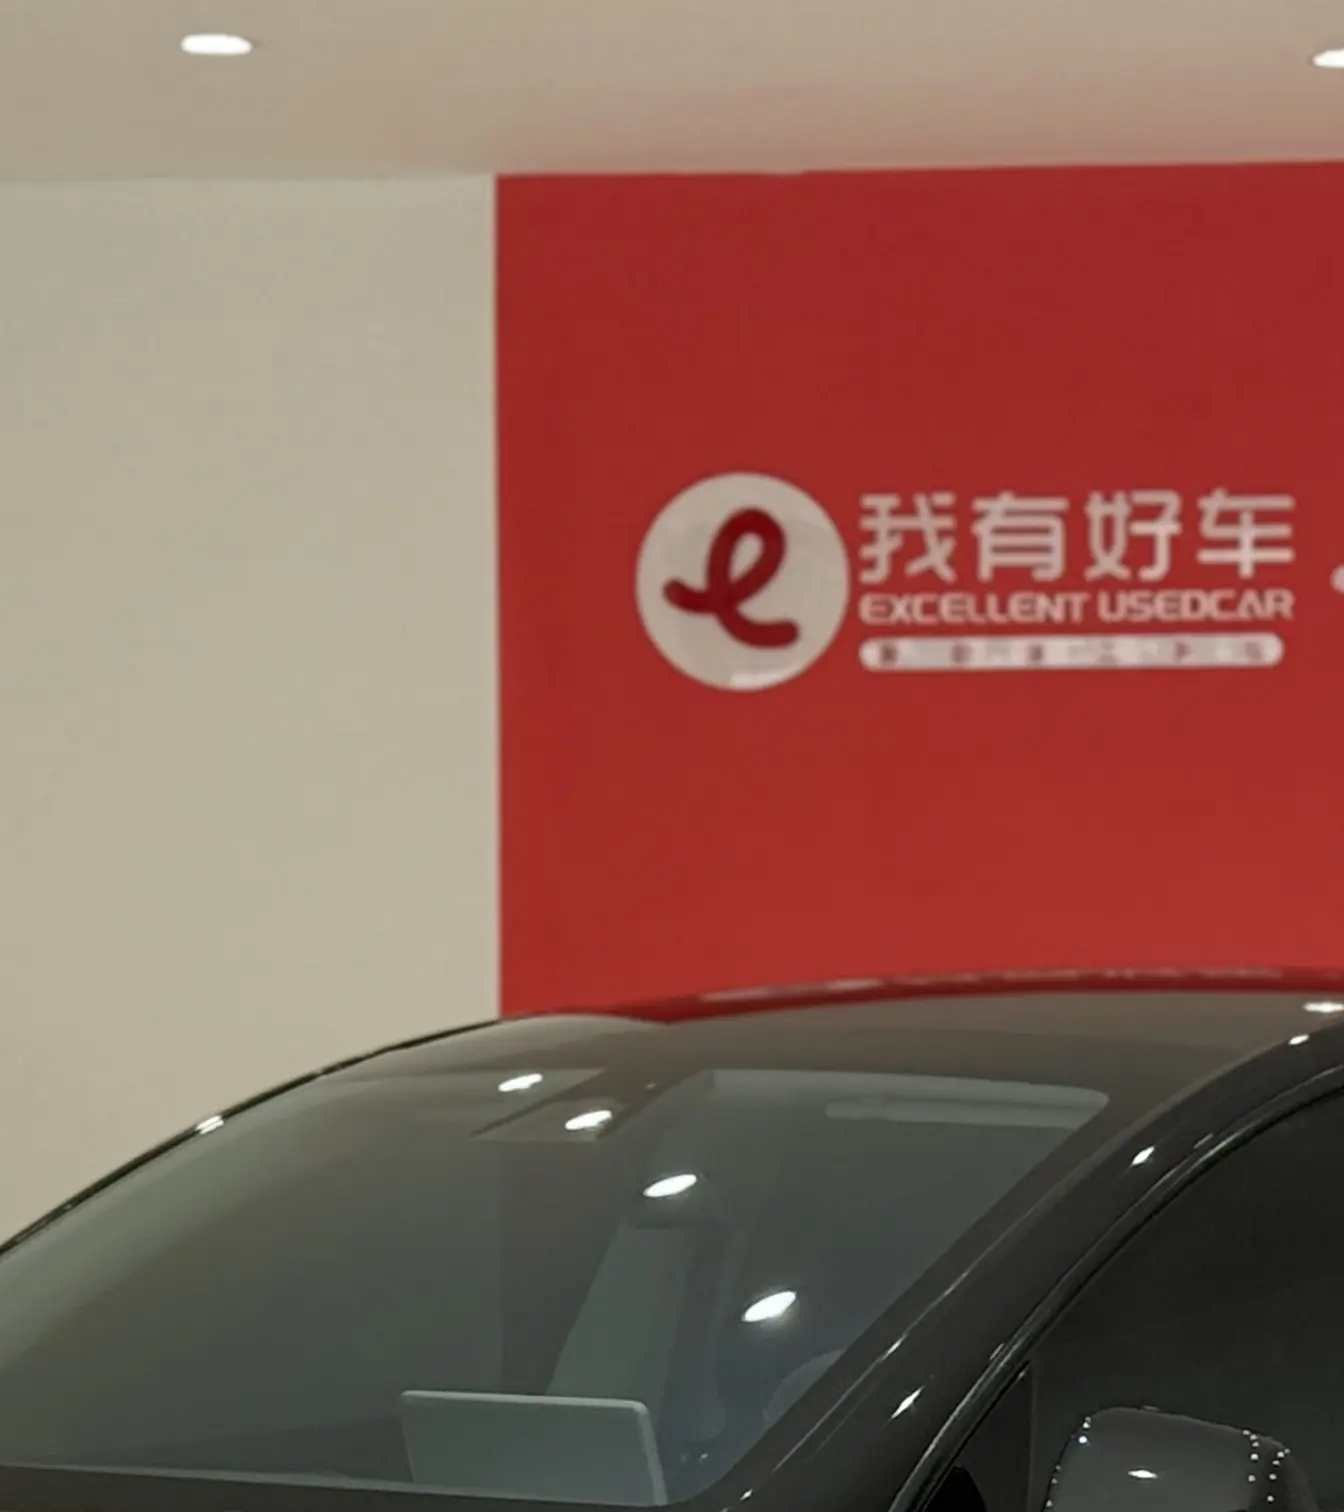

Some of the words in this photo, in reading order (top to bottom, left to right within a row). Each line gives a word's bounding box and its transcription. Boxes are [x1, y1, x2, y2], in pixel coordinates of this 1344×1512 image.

[859, 488, 1295, 583] 我有好车
[859, 593, 1089, 624] EXCELLENT
[1097, 589, 1295, 622] USEDCAR
